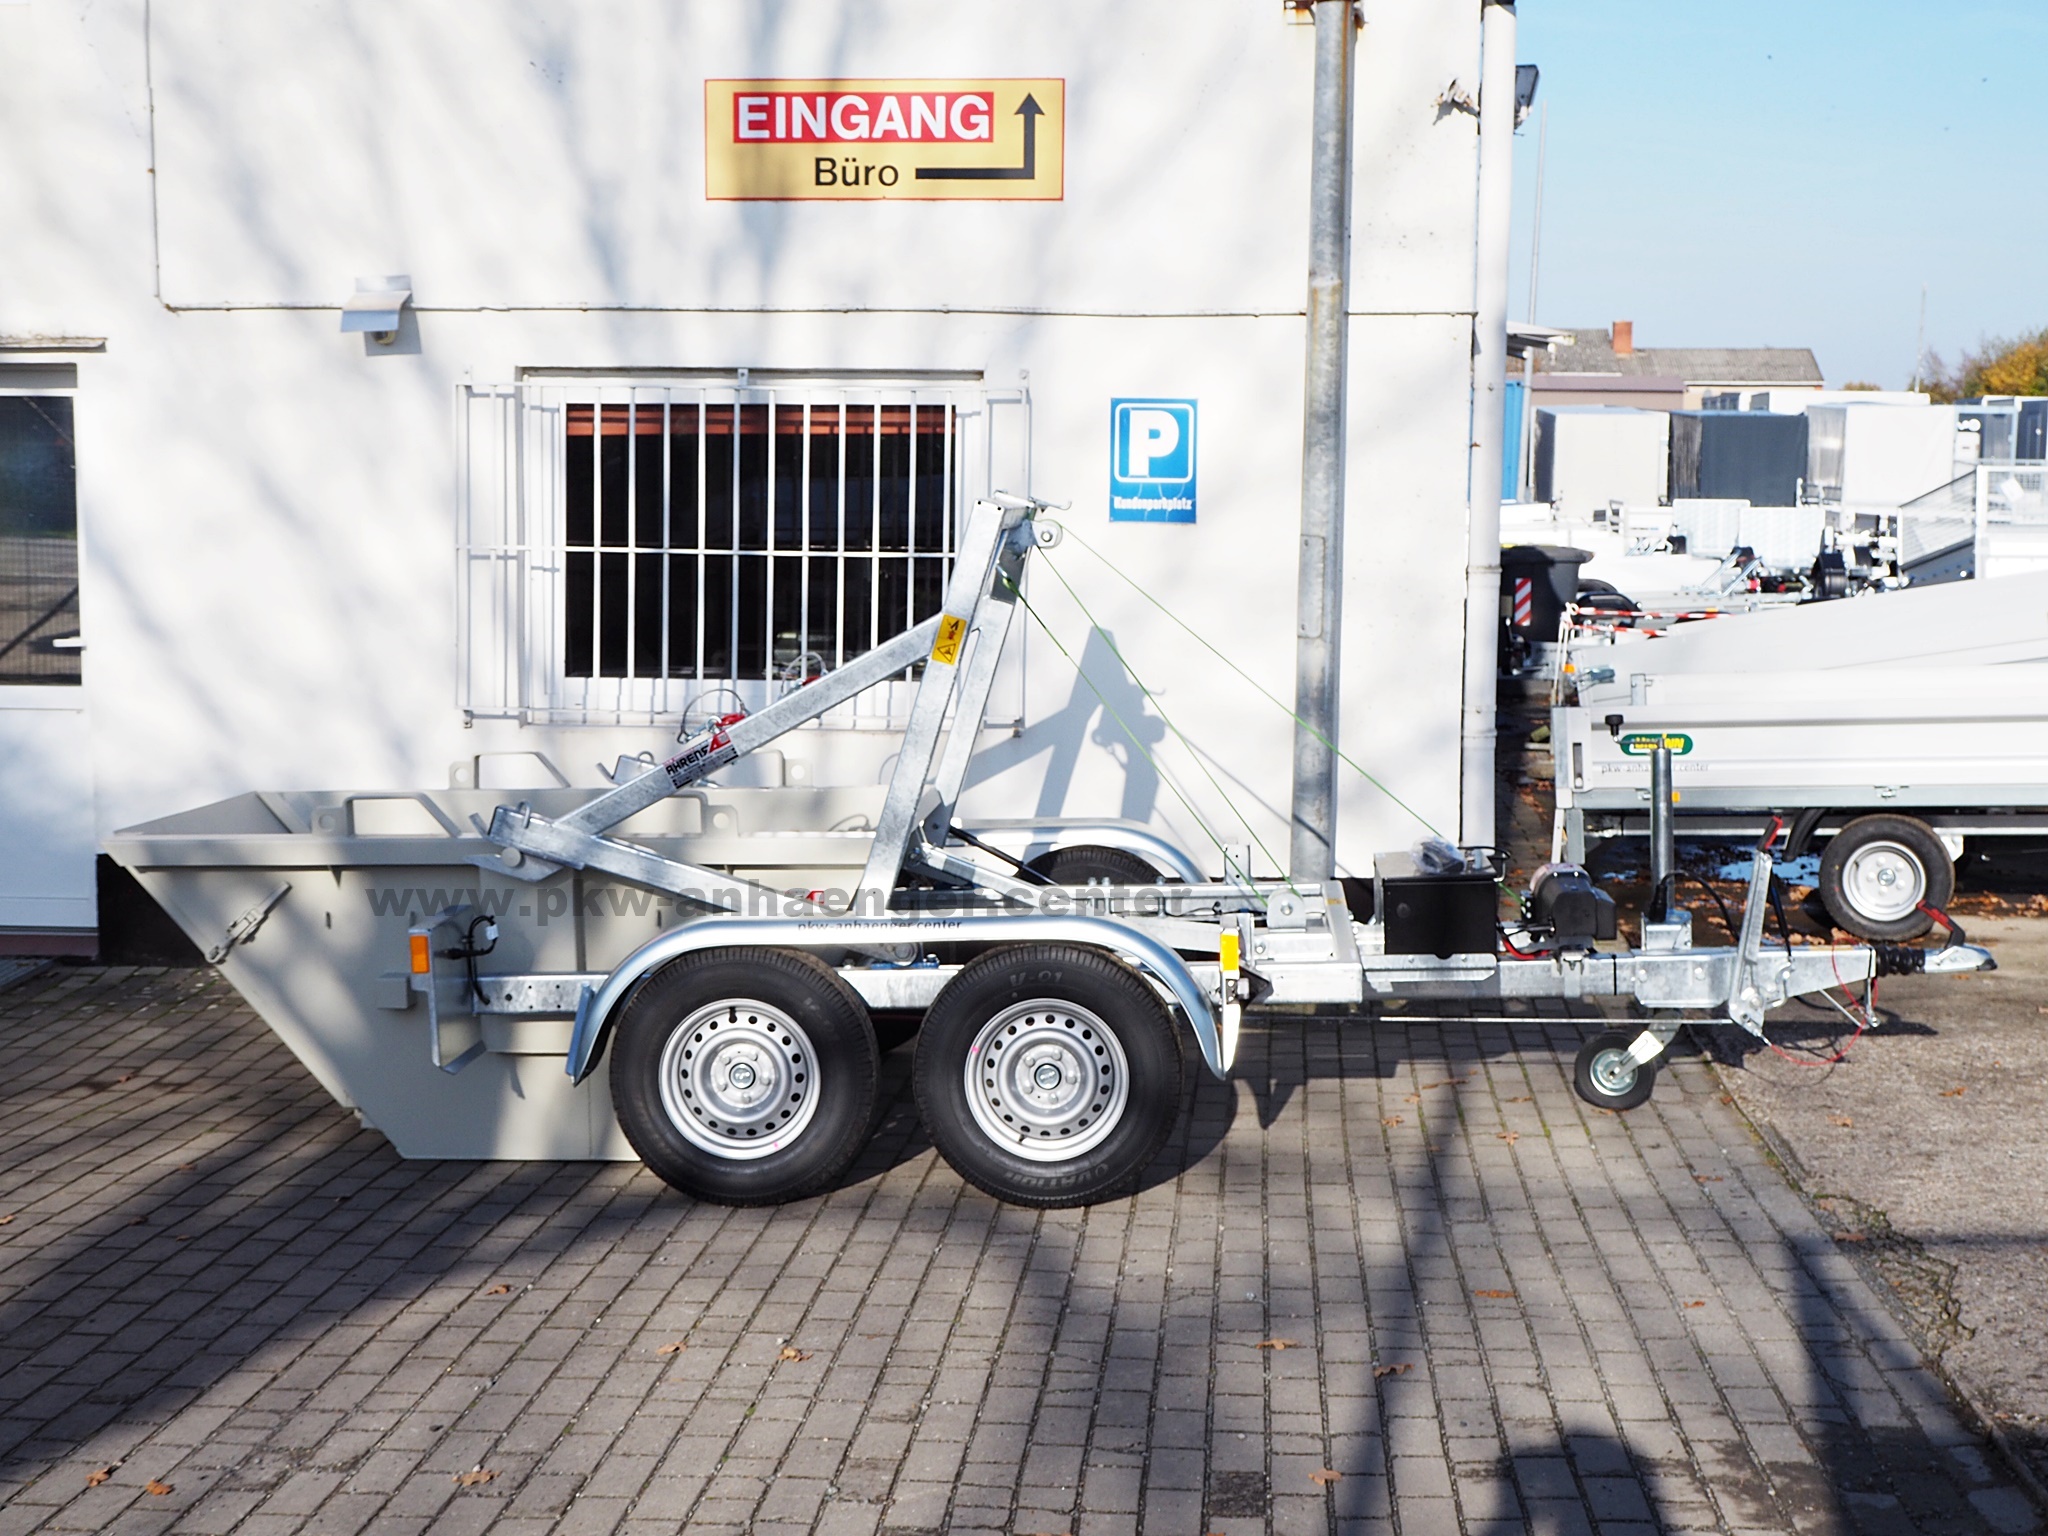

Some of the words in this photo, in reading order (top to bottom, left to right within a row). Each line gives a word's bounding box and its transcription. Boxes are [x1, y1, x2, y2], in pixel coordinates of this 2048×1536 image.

[737, 95, 990, 140] EINGANG
[814, 157, 899, 186] Büro
[1128, 409, 1180, 477] P
[665, 744, 710, 776] AHRENS
